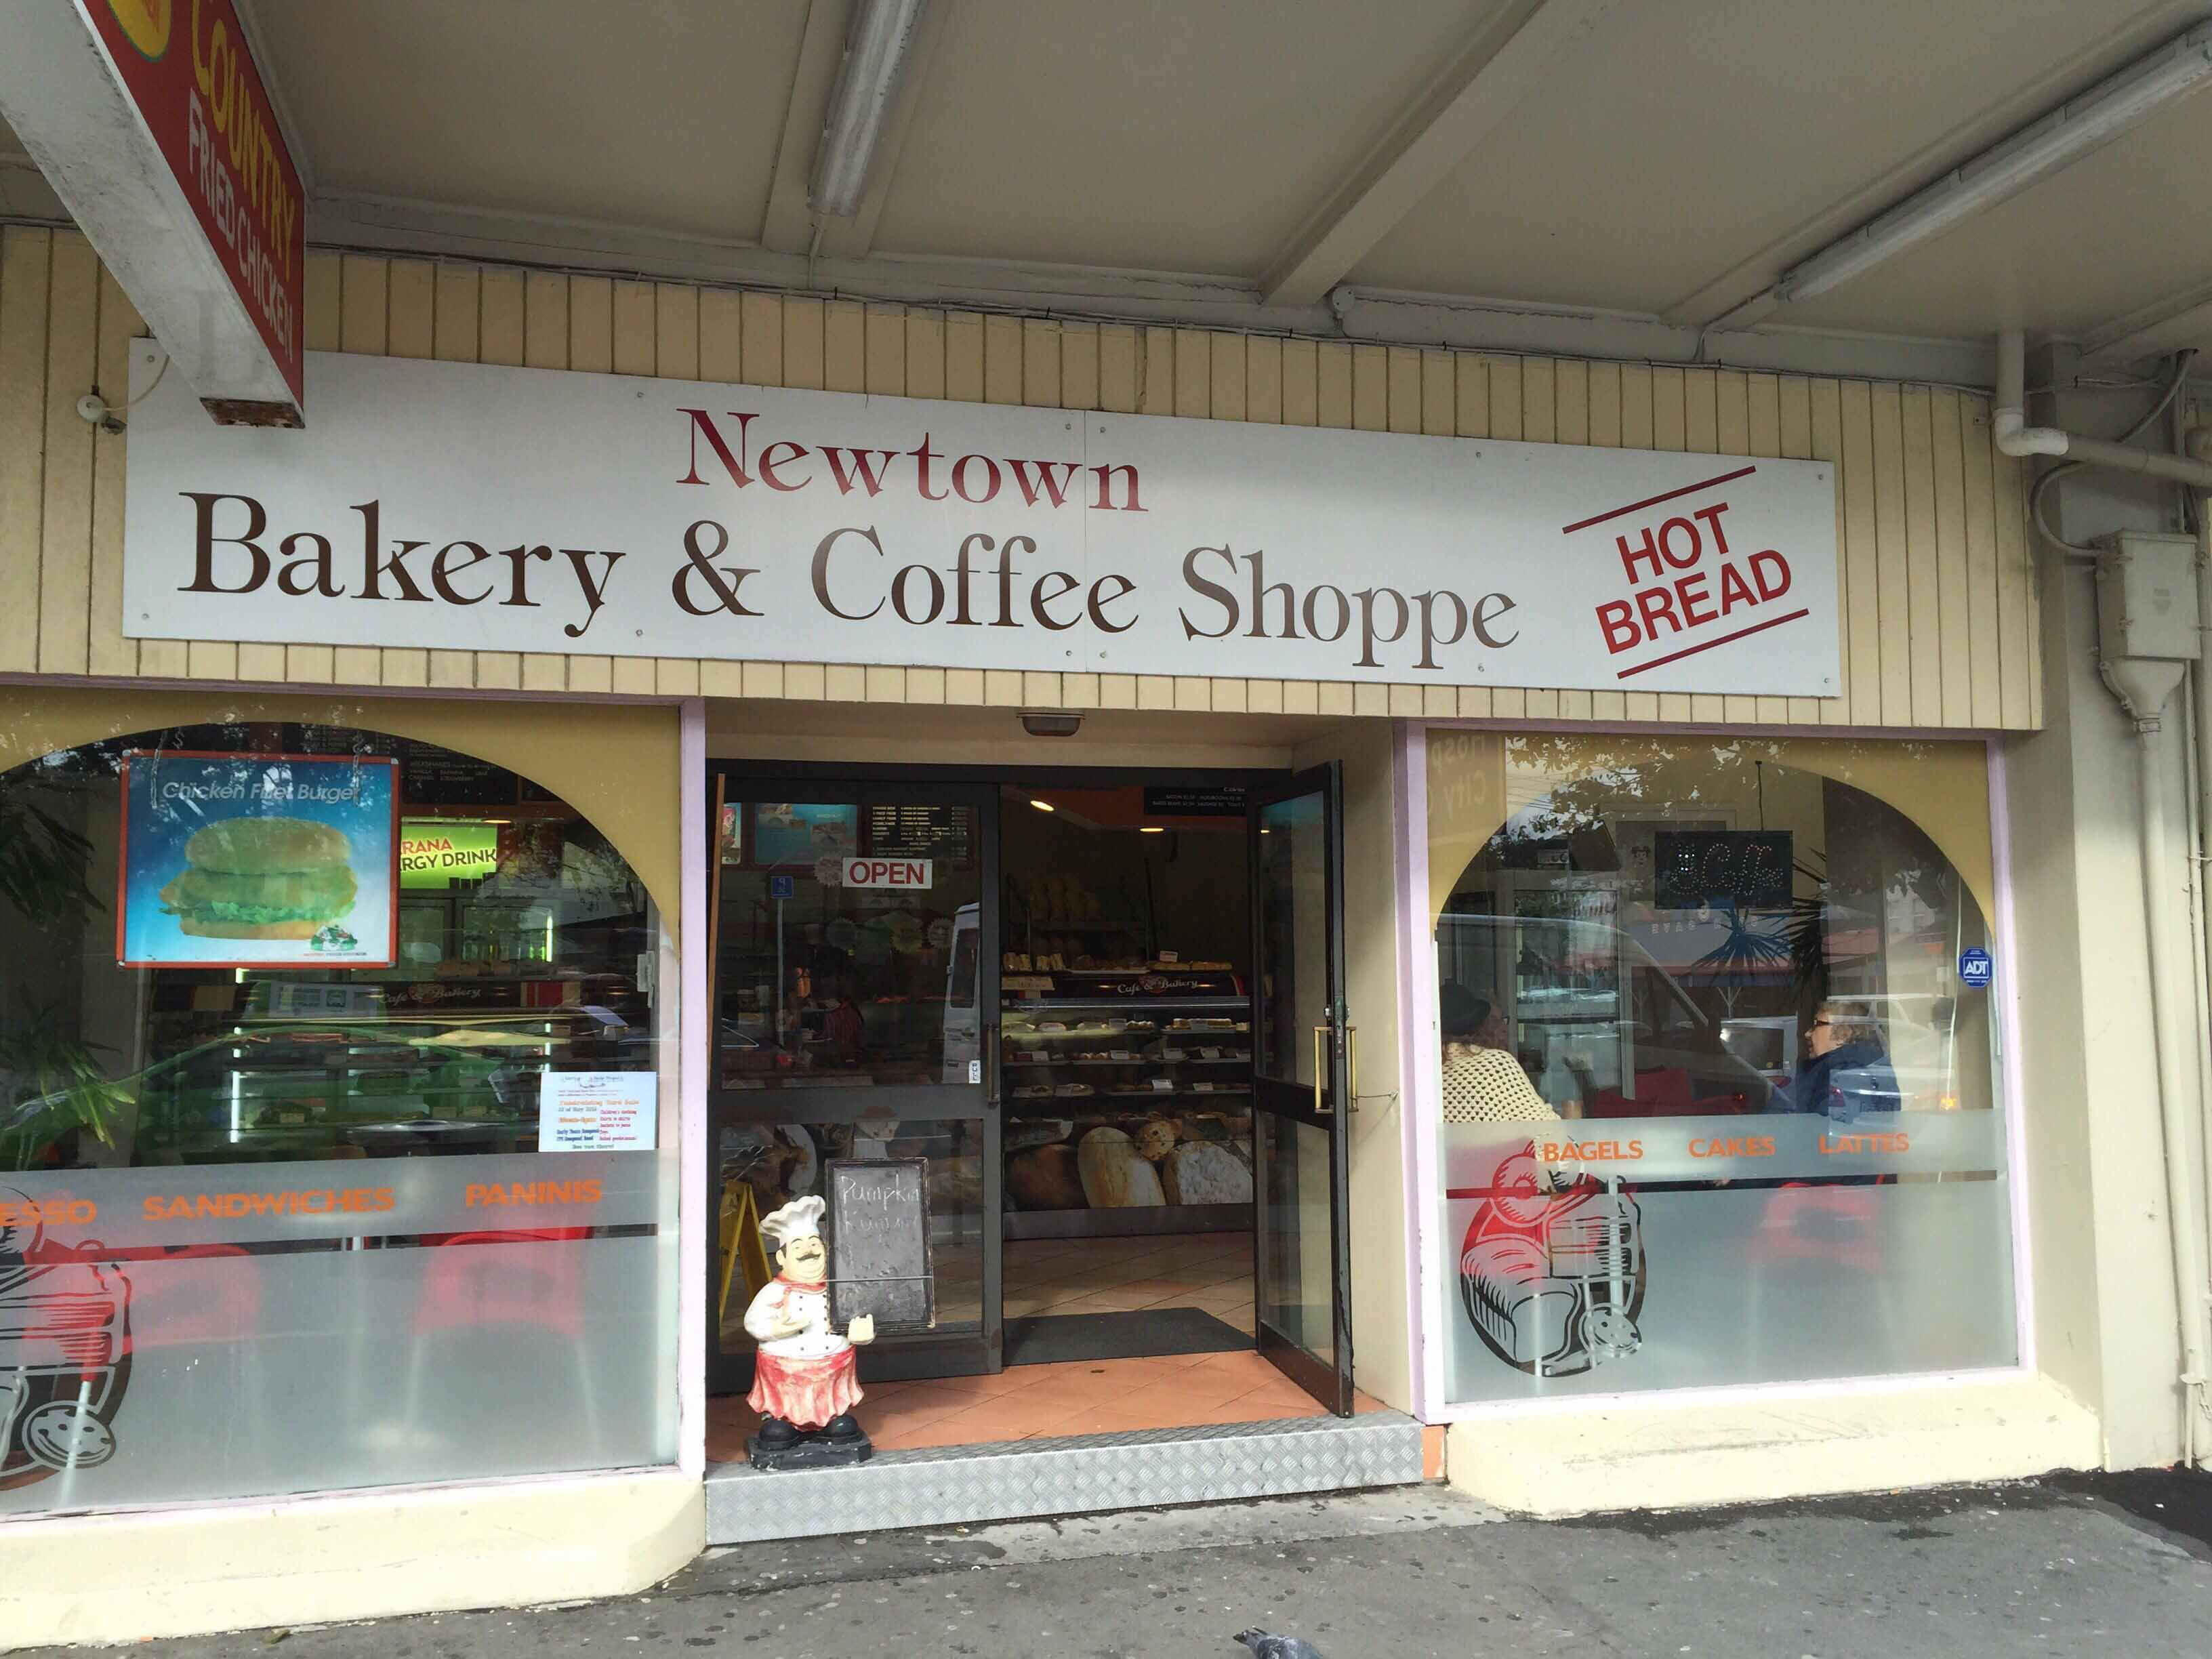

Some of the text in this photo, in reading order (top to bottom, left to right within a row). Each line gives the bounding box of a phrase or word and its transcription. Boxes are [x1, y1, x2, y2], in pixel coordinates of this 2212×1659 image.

[192, 0, 294, 282] COUNTRY
[189, 87, 293, 363] FRIED CHICKEN
[676, 409, 1148, 512] Newtown
[1616, 502, 1729, 585] HOT
[177, 492, 1519, 669] Bakery & Coffee Shoppe
[1595, 550, 1791, 655] BREAD
[163, 781, 245, 800] Chicken
[298, 784, 360, 804] Burger
[400, 838, 453, 855] RANA
[400, 848, 497, 871] RGY DRINK
[849, 861, 924, 884] OPEN
[1158, 977, 1197, 989] Bakery
[1965, 960, 1988, 975] ADT
[1544, 1132, 1910, 1162] BAGELS CAKES LATTES
[0, 1179, 602, 1227] ESSO SANDWICHES PANINIS
[840, 1174, 920, 1211] Pumpkin
